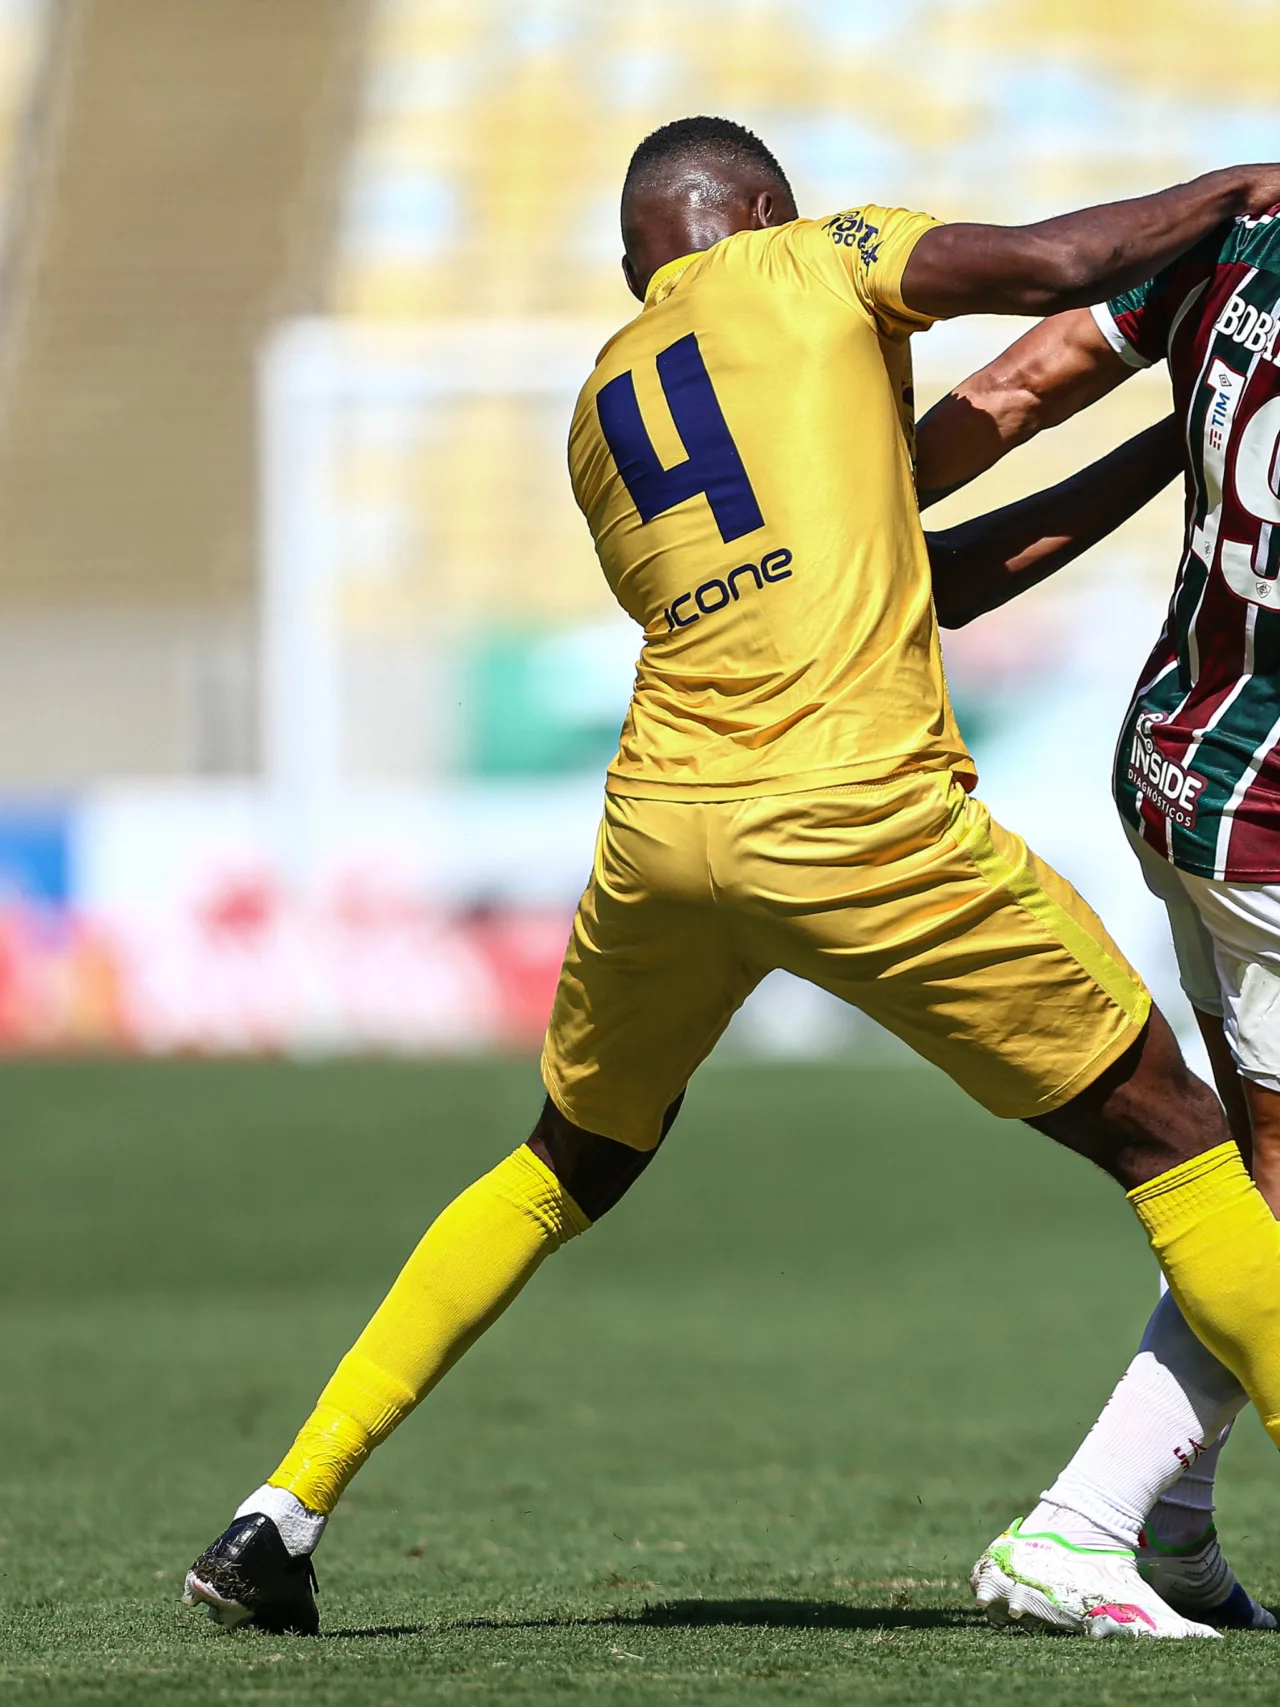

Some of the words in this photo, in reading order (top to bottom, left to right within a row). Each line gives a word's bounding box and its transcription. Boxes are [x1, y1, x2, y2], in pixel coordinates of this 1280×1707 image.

[596, 331, 765, 544] 4
[1211, 391, 1232, 428] TIM
[1127, 768, 1192, 828] DIAGNÓSTICOS
[1130, 735, 1203, 812] INSIDE
